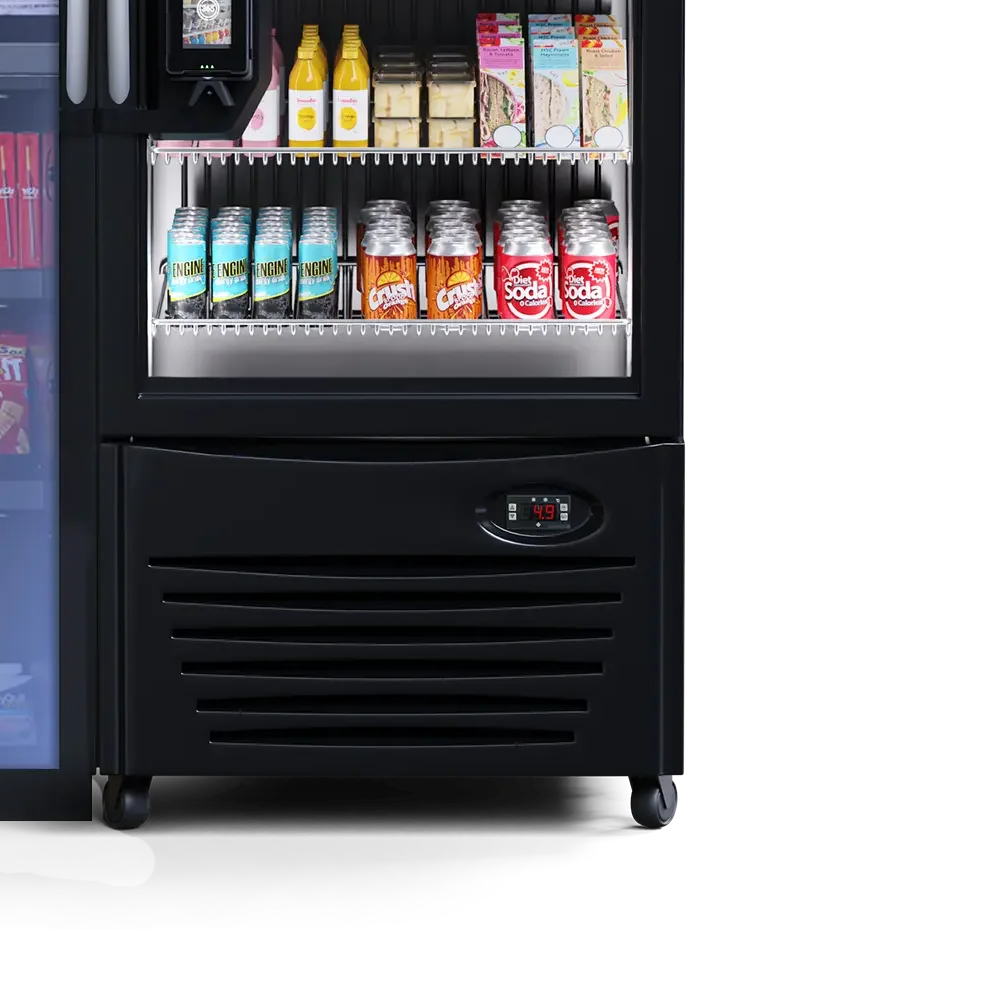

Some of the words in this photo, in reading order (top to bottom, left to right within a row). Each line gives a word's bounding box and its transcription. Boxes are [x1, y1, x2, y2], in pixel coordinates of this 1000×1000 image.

[172, 257, 205, 278] ENGINE
[256, 257, 288, 278] ENGINE
[300, 257, 333, 278] ENGINE
[504, 280, 549, 301] Soda
[512, 275, 532, 286] Diet
[568, 275, 585, 286] Diet
[368, 280, 417, 311] Crush
[533, 504, 555, 520] 4.9
